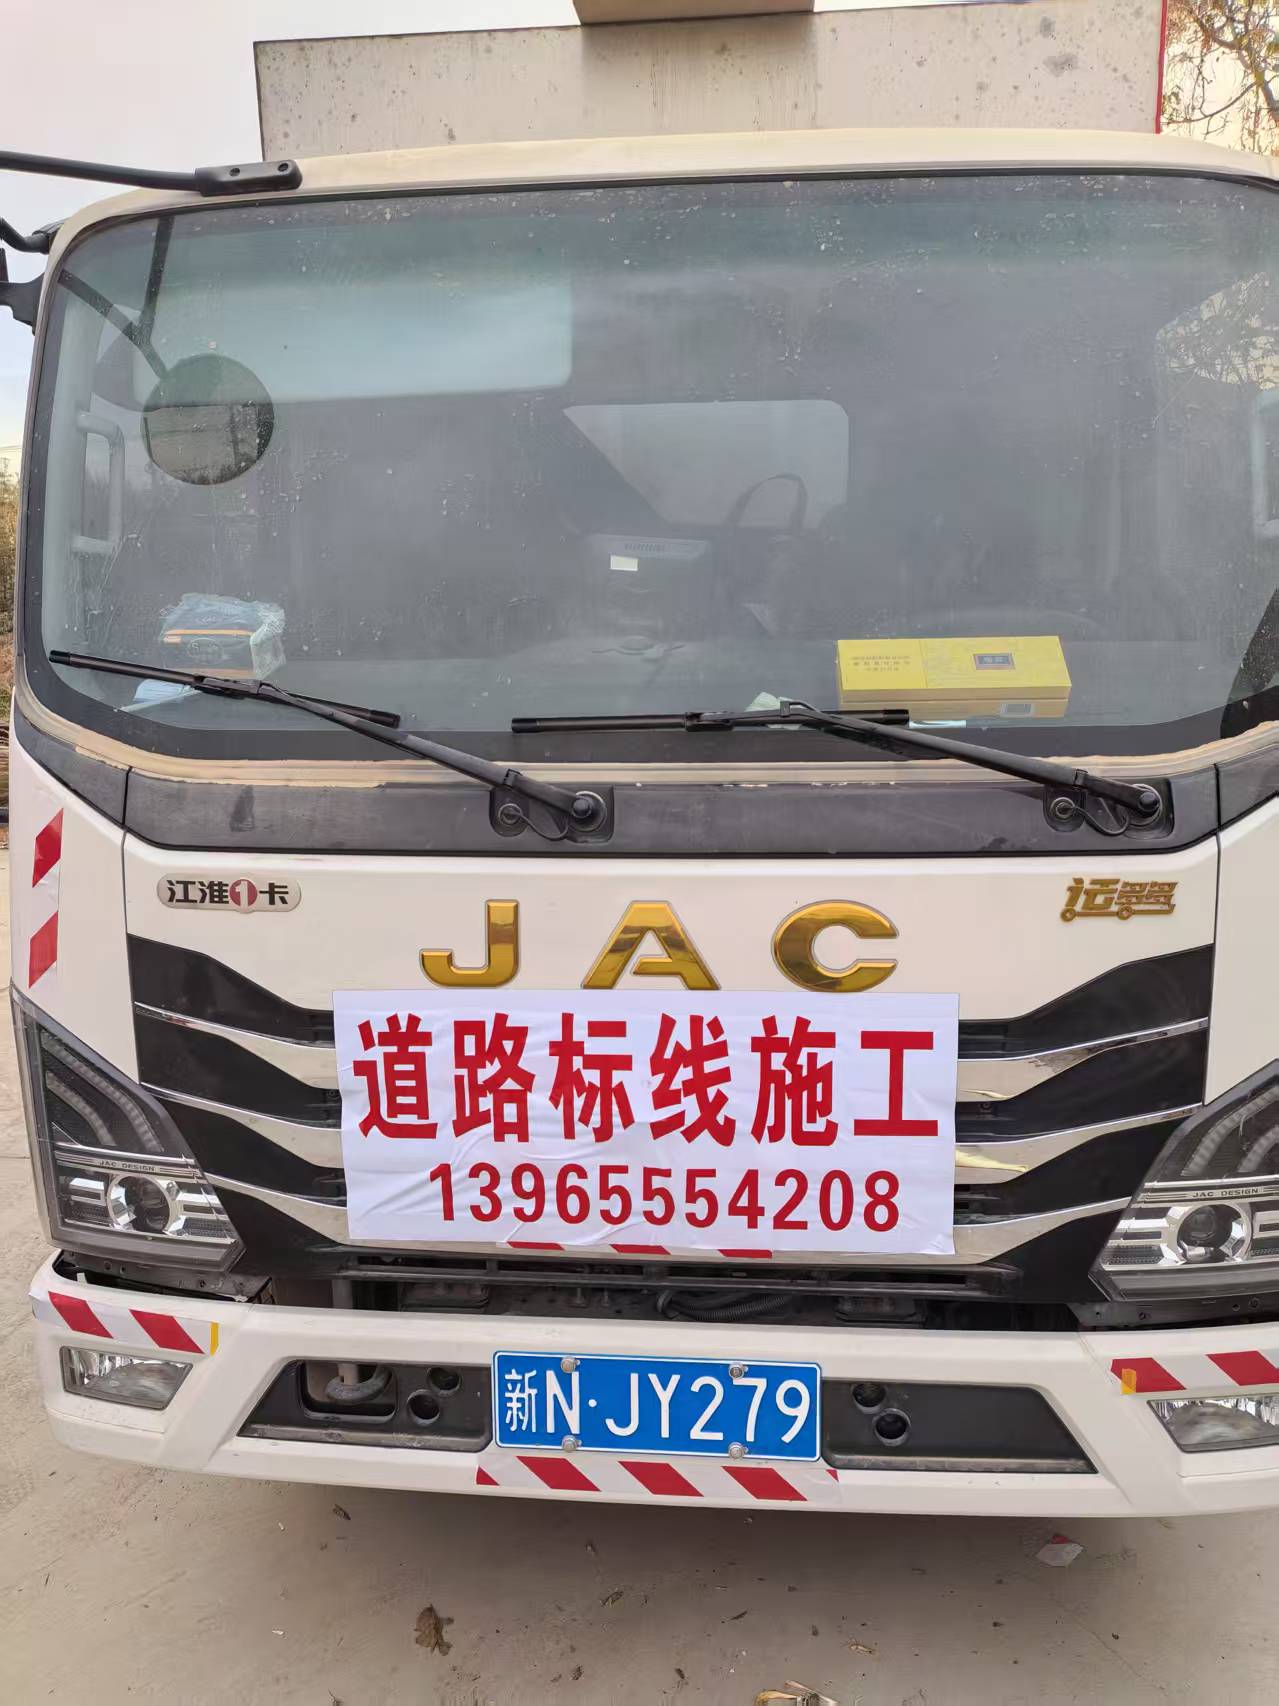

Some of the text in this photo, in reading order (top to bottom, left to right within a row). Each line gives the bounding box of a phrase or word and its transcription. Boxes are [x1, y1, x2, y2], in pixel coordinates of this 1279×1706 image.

[420, 900, 900, 992] JAC
[352, 1012, 939, 1147] 道路标线施工
[99, 1159, 156, 1172] JAC DESIGN
[429, 1162, 900, 1232] 13965554208
[1220, 1187, 1259, 1197] DESIGN
